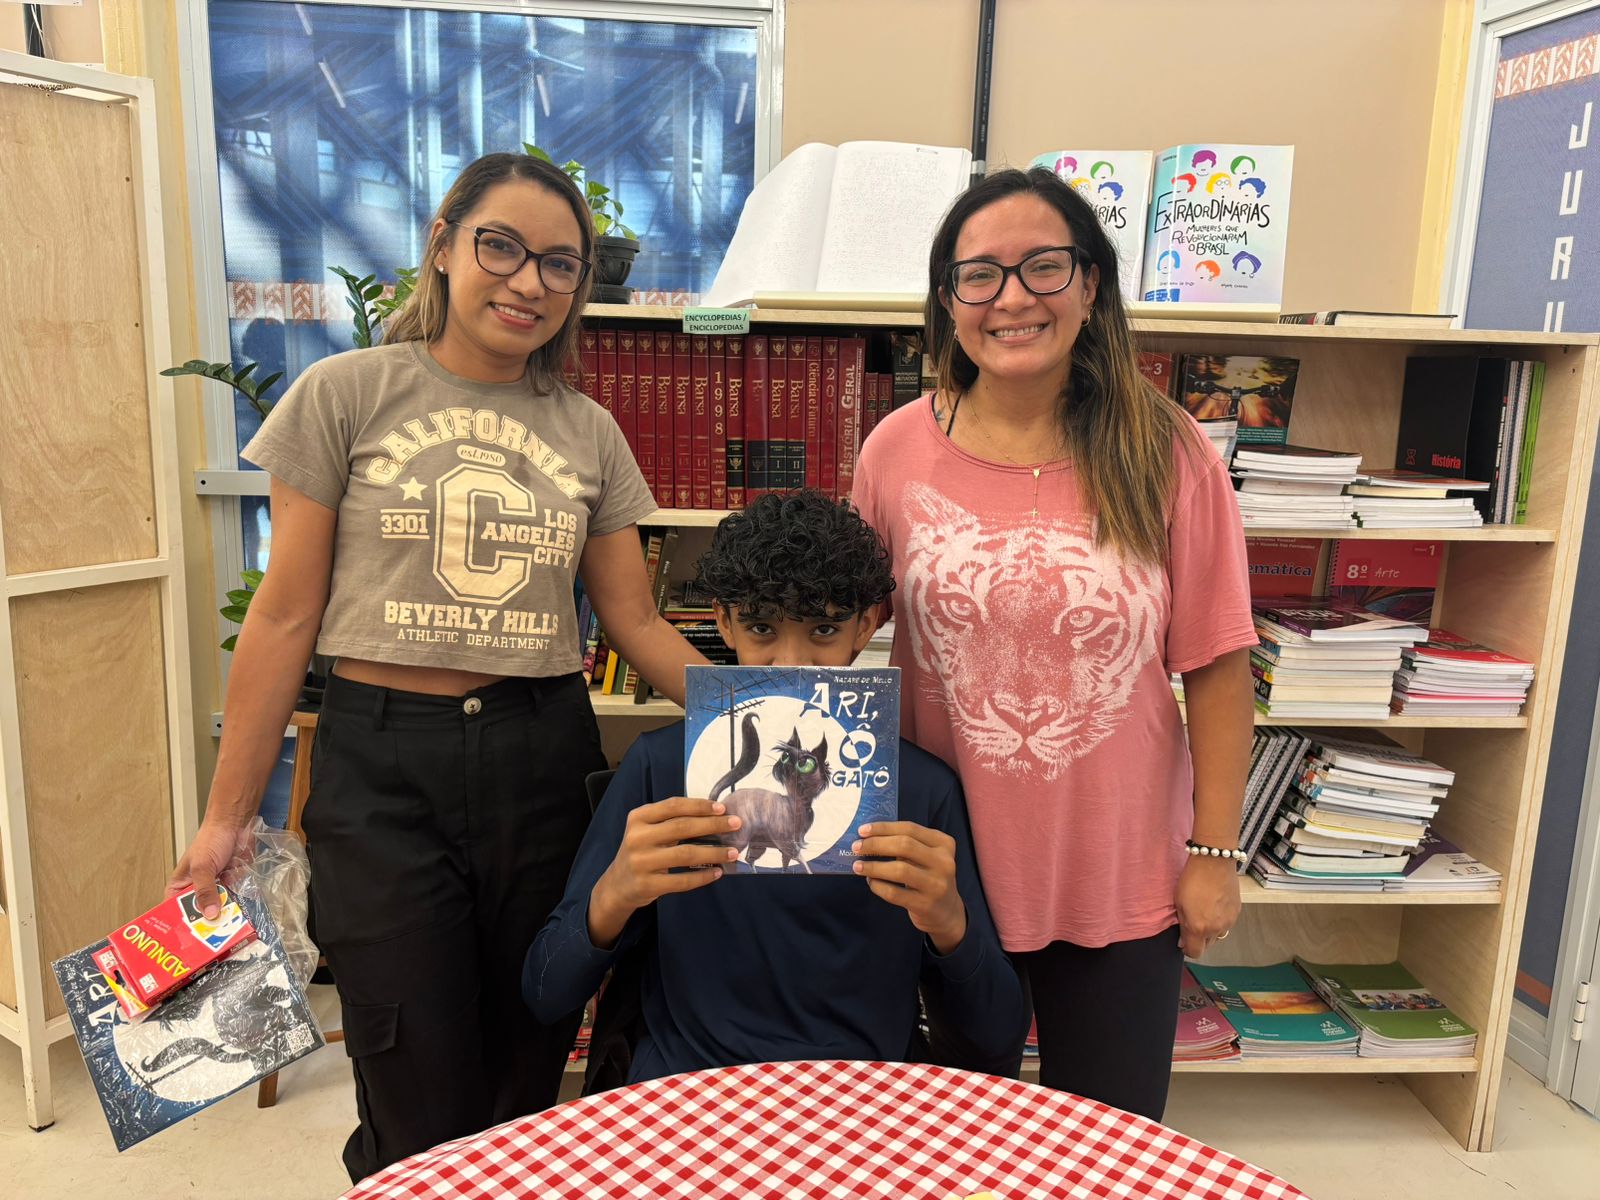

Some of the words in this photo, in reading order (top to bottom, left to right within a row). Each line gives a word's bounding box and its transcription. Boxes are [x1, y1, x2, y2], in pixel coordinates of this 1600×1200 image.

[1186, 224, 1222, 234] MULHERES
[1225, 224, 1239, 232] QUE
[1188, 243, 1196, 252] O
[1196, 242, 1229, 256] BRASIL
[685, 313, 742, 322] ENCYCLOPEDIAS
[689, 324, 744, 332] ENCICLOPEDIAS
[808, 362, 820, 397] Ciência
[1153, 362, 1162, 375] 3
[621, 374, 635, 414] Barsa
[640, 375, 653, 414] Barsa
[658, 375, 671, 415] Barsa
[677, 376, 690, 415] Barsa
[695, 377, 708, 416] Barsa
[729, 377, 743, 418] Barsa
[772, 379, 786, 419] Barsa
[790, 379, 804, 419] Barsa
[841, 364, 855, 409] GERAL
[808, 405, 819, 438] Futuro
[365, 407, 585, 500] CALIFORNIA
[1432, 454, 1461, 470] História
[380, 514, 428, 534] 3301
[432, 463, 537, 606] C
[481, 521, 576, 550] ANGELES
[544, 509, 577, 531] LOS
[533, 547, 574, 568] CITY
[1429, 545, 1436, 556] 1
[1249, 562, 1312, 576] emática
[1346, 564, 1368, 579] 8º
[1374, 567, 1400, 578] Arte
[384, 600, 498, 630] BEVERLY
[502, 611, 559, 635] HILLS
[397, 628, 459, 643] ATHLETIC
[466, 633, 550, 650] DEPARTMENT
[799, 682, 879, 721] ARI,
[123, 925, 191, 978] ADNUNO
[1212, 981, 1228, 991] 5
[1324, 977, 1340, 989] 5
